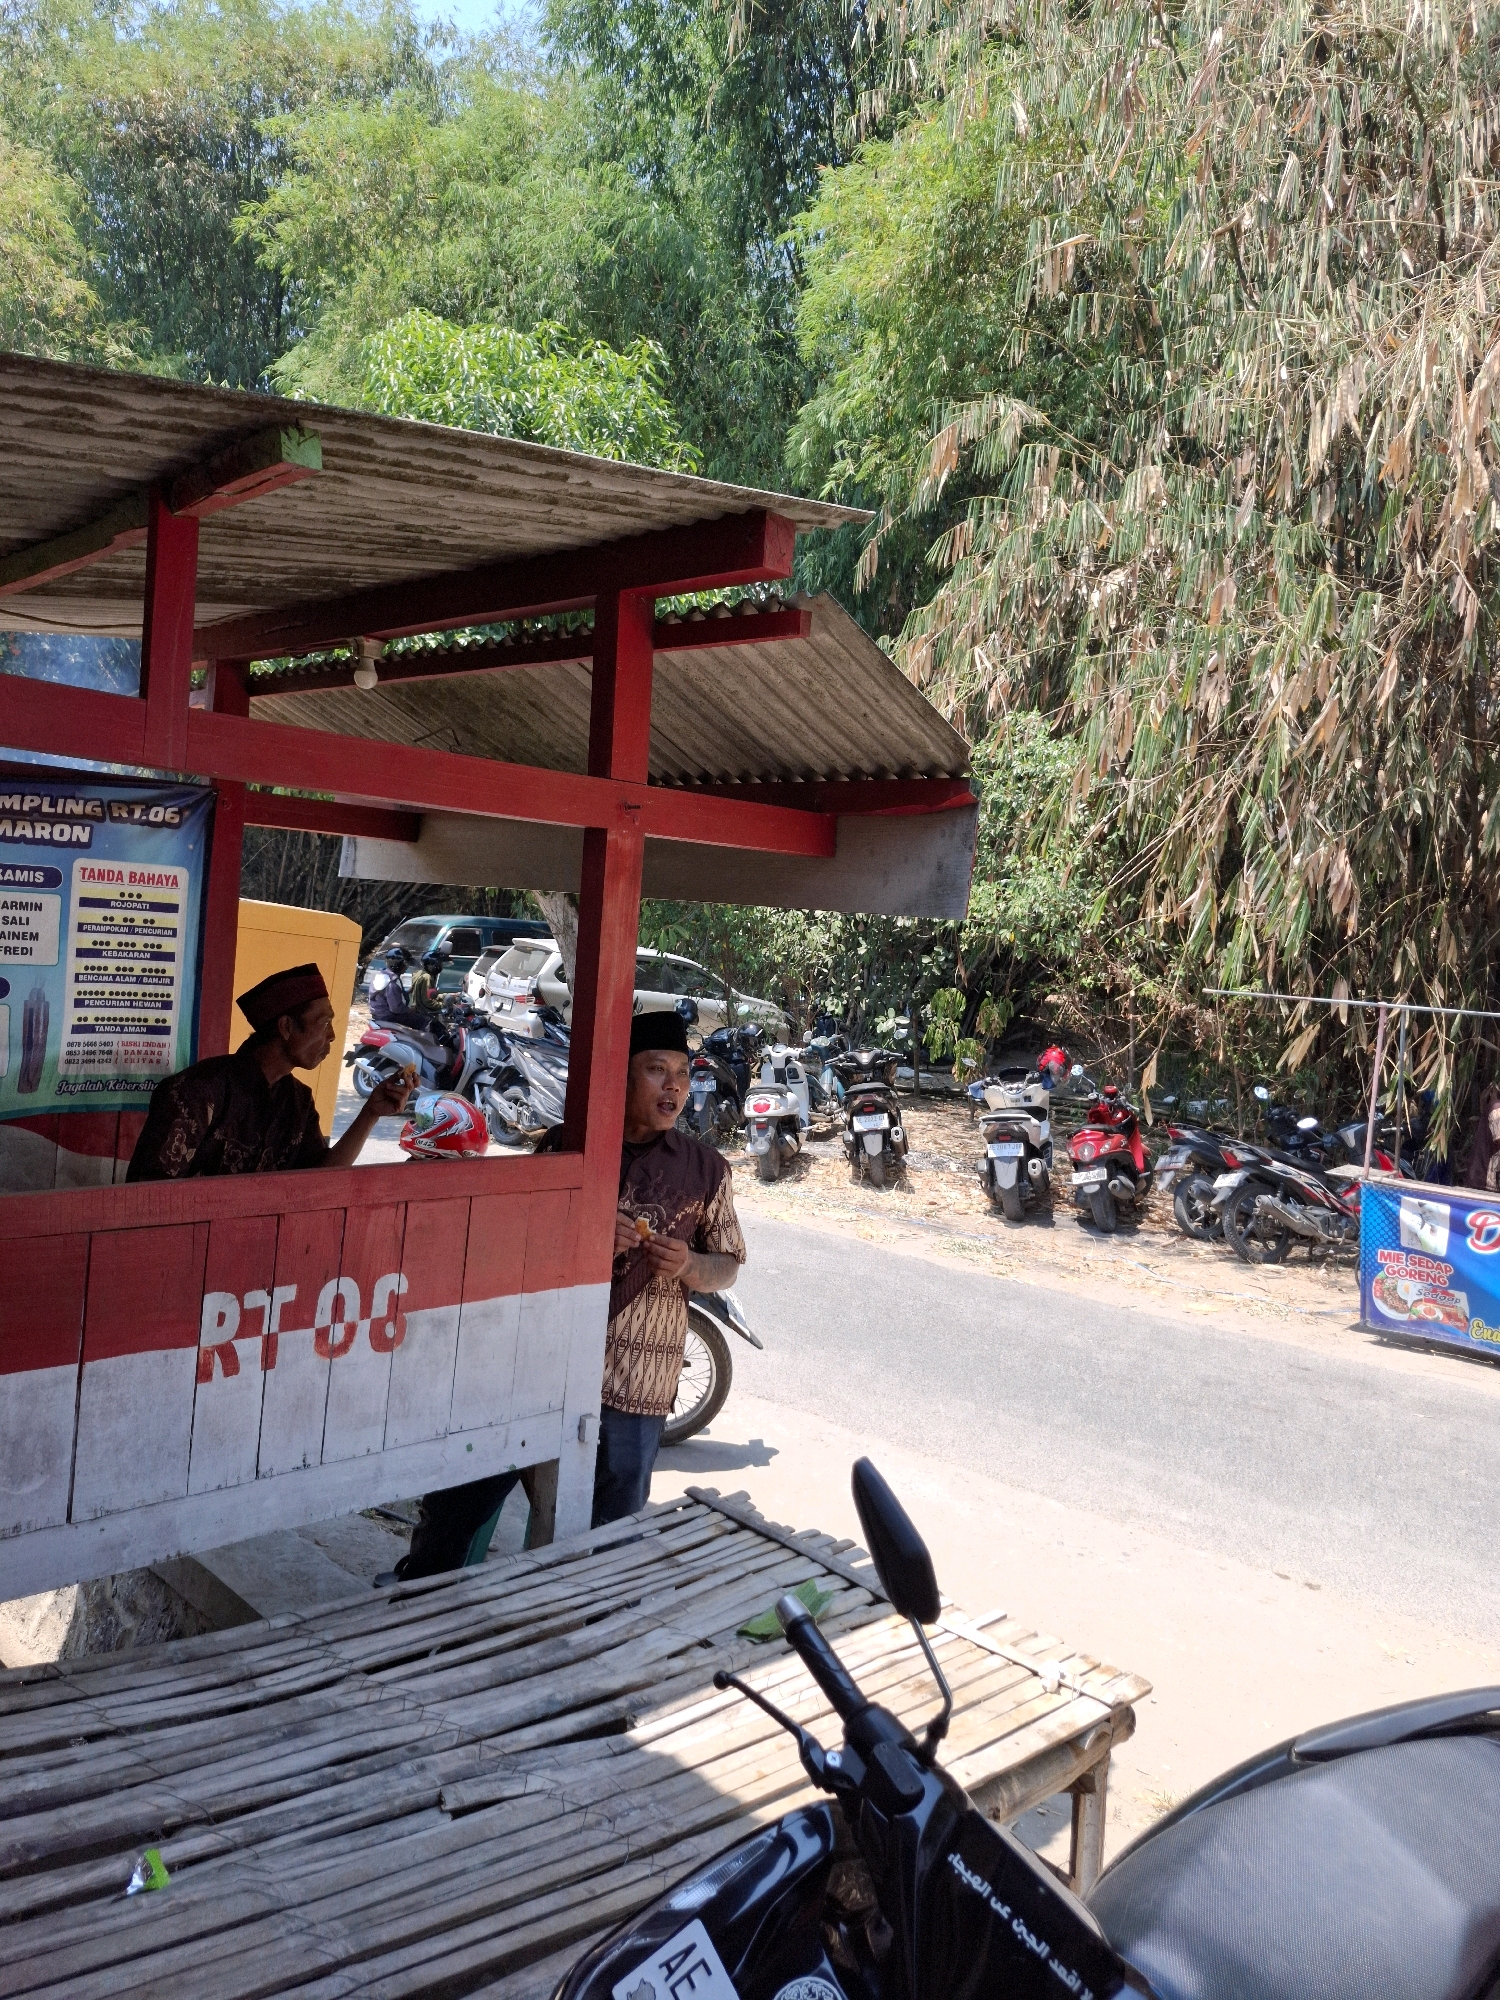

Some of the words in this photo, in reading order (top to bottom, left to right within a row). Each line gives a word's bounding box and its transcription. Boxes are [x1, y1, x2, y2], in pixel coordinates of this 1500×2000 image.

[110, 802, 180, 824] RT.06
[80, 867, 124, 882] TANDA
[129, 871, 179, 888] BAHAYA
[110, 901, 150, 910] ROJOPATI
[2, 916, 30, 926] SALI
[82, 924, 129, 933] PERAMPOKAN
[134, 927, 173, 936] PENCURIAN
[102, 950, 151, 959] KEBAKARAN
[78, 974, 114, 982] BENCANA
[142, 977, 171, 985] BANJIR
[84, 999, 131, 1007] PENCURIAN
[94, 1025, 122, 1033] TANDA
[123, 1025, 147, 1033] AMAN
[56, 1080, 103, 1095] Jagalah
[1379, 1250, 1405, 1265] MIE
[1408, 1255, 1453, 1275] SEDAP
[1385, 1264, 1448, 1286] GORENG
[197, 1283, 298, 1385] RT
[313, 1272, 409, 1360] 06
[658, 1942, 713, 2000] AE
